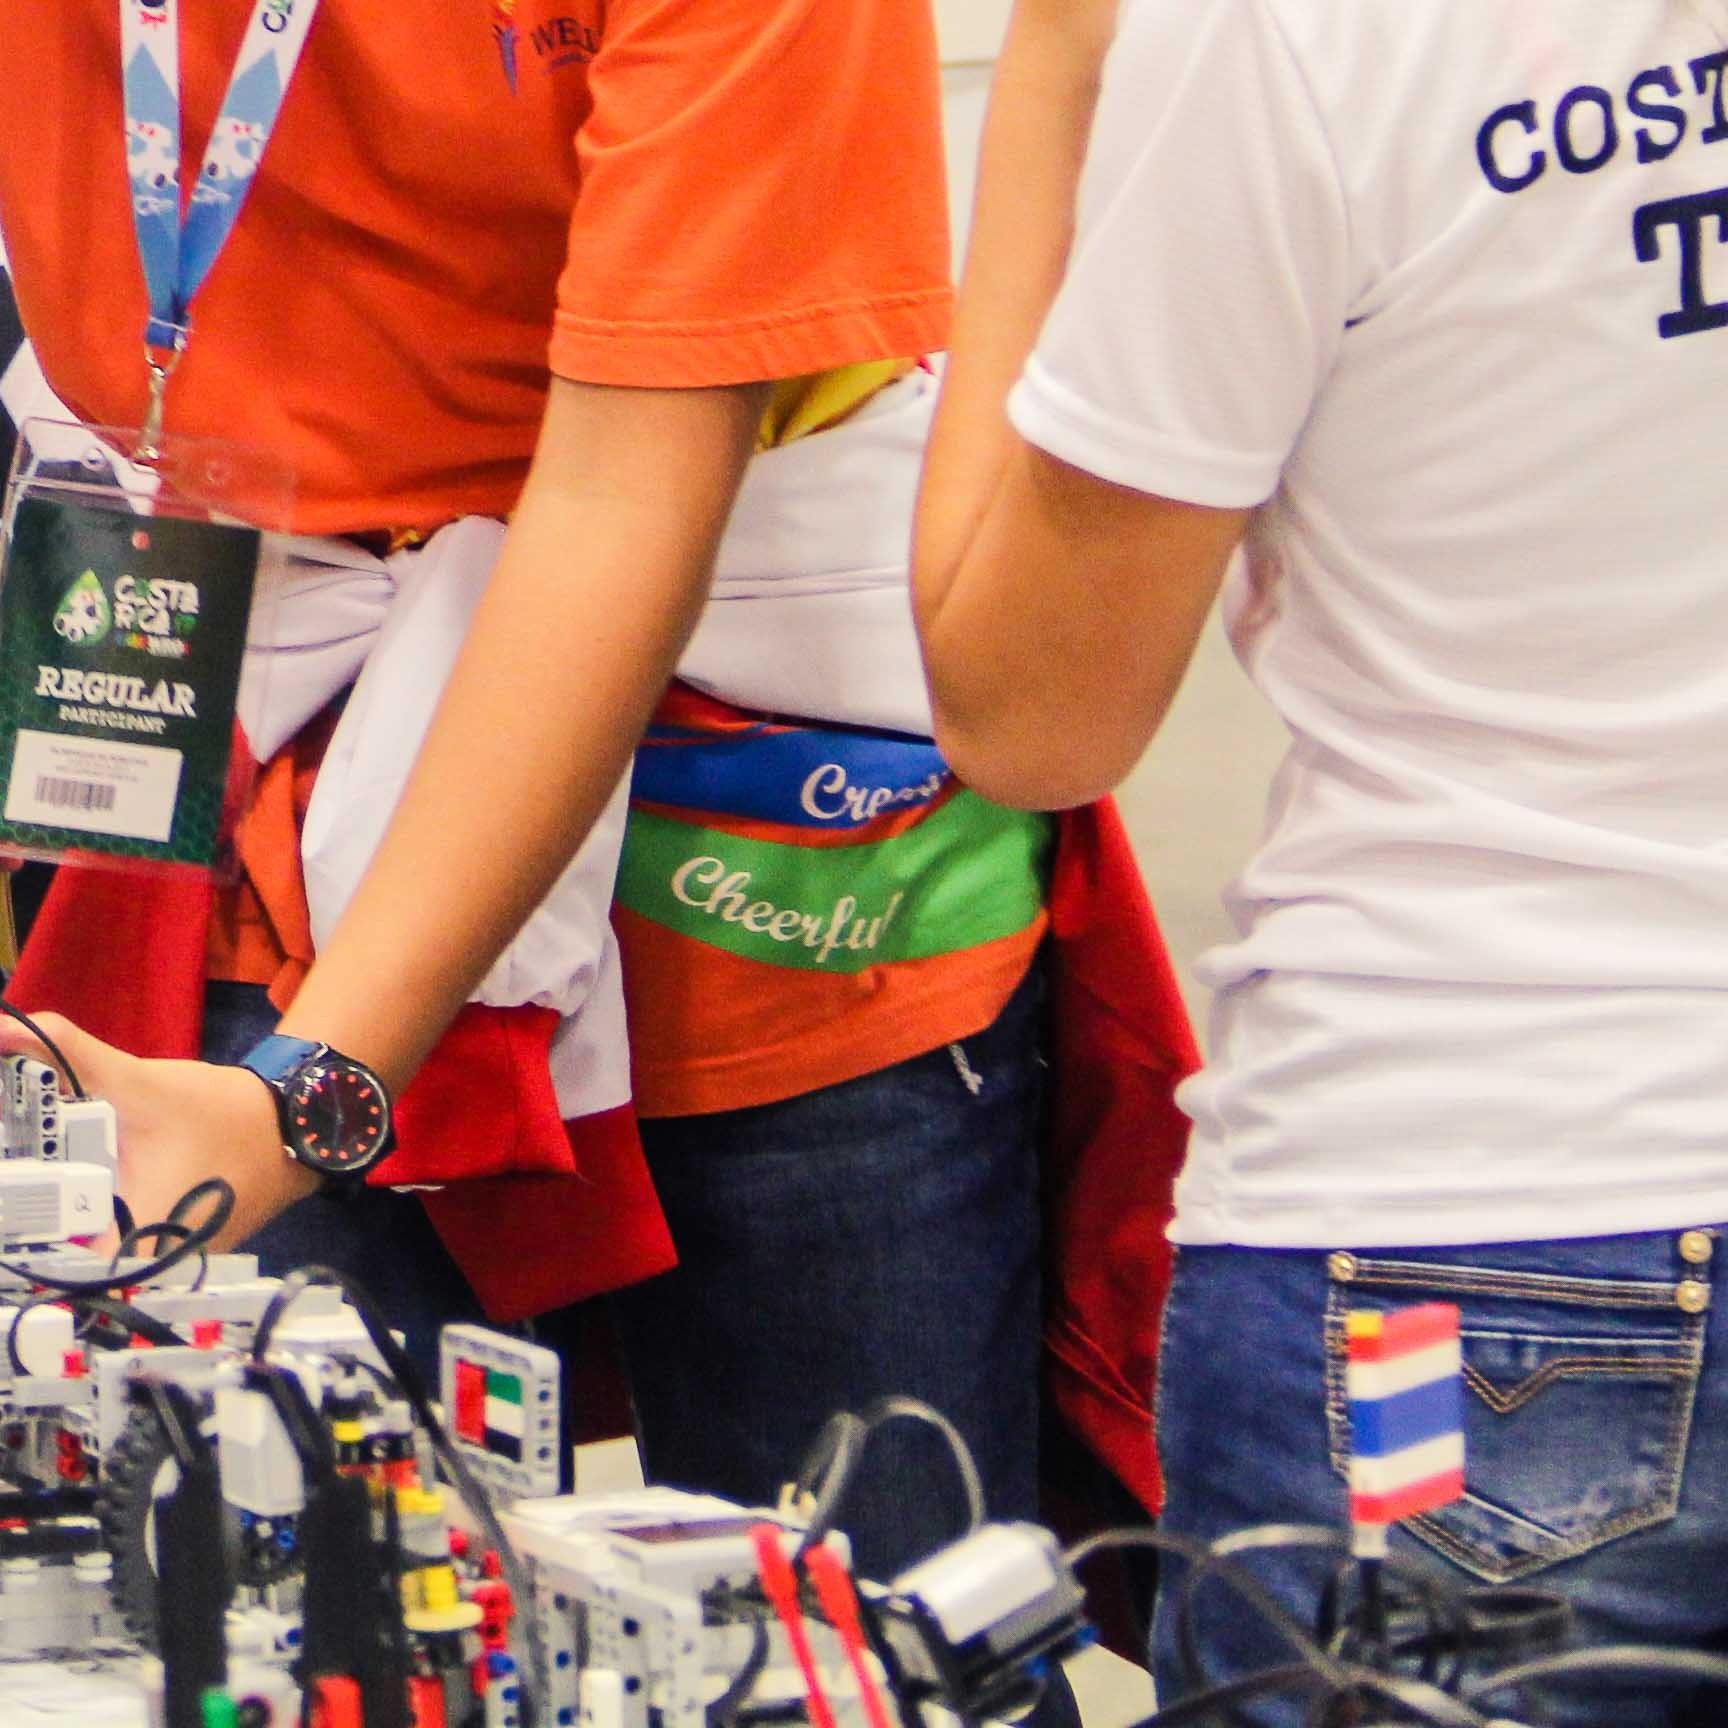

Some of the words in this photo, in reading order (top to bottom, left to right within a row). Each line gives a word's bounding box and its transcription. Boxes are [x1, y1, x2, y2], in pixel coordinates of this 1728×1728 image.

[1475, 50, 1728, 193] COST
[1632, 186, 1728, 340] T
[114, 574, 200, 614] COSTA
[34, 665, 197, 718] REGULAR
[670, 856, 904, 963] Cheerful
